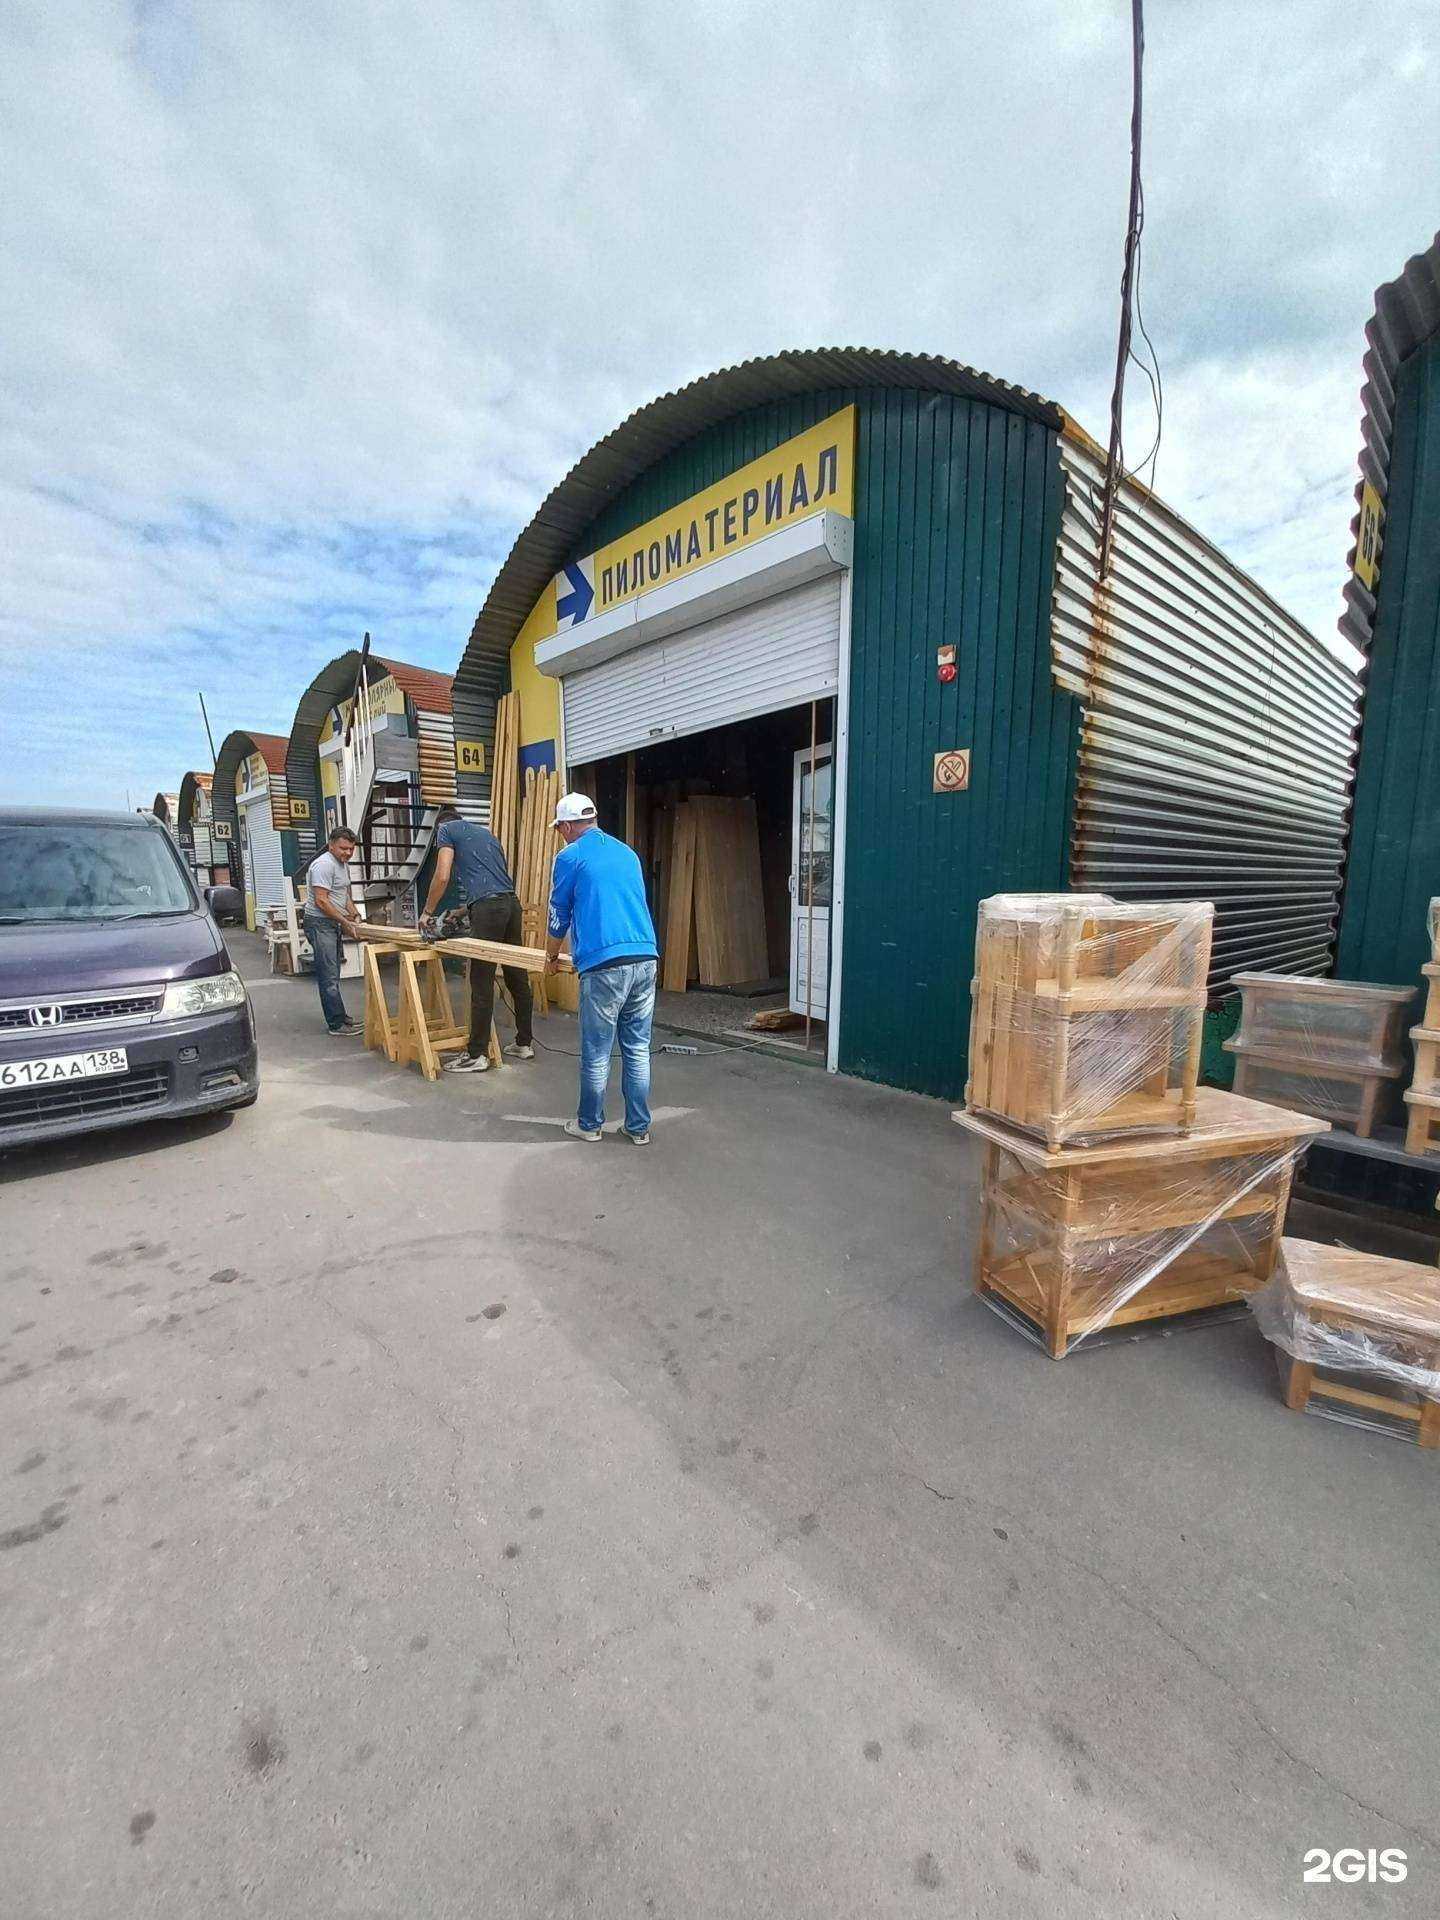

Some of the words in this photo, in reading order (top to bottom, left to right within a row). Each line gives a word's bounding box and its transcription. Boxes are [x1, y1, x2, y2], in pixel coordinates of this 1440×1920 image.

[602, 444, 838, 605] ПИЛОМАТЕРИАЛ
[462, 747, 480, 766] 64
[294, 804, 306, 814] 63
[217, 825, 230, 836] 62
[87, 1051, 120, 1067] 138
